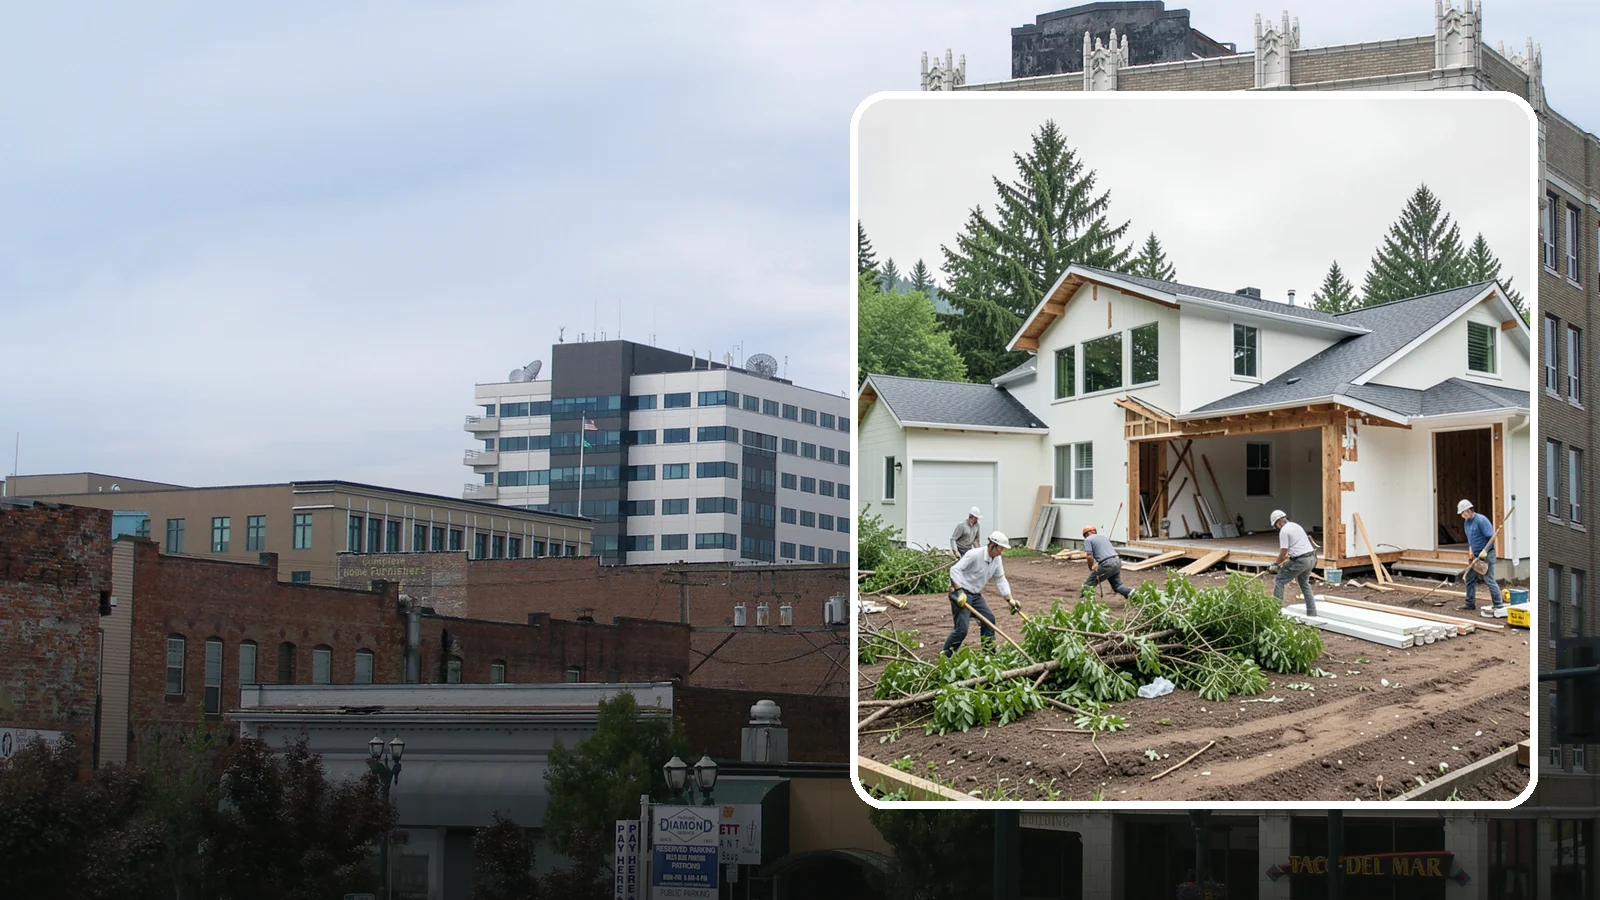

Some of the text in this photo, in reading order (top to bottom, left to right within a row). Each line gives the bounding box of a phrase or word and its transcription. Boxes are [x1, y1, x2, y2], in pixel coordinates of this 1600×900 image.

[370, 566, 427, 576] Furnishers
[660, 818, 713, 832] DIAMOND
[1021, 813, 1070, 827] BUILDING
[689, 846, 716, 854] PARKING
[721, 852, 739, 861] Soup
[617, 825, 625, 893] PAY HERE
[628, 825, 636, 893] PAY HERE
[1289, 855, 1442, 876] TAC DEL MAR
[660, 888, 710, 898] PUBLIC PARKING
